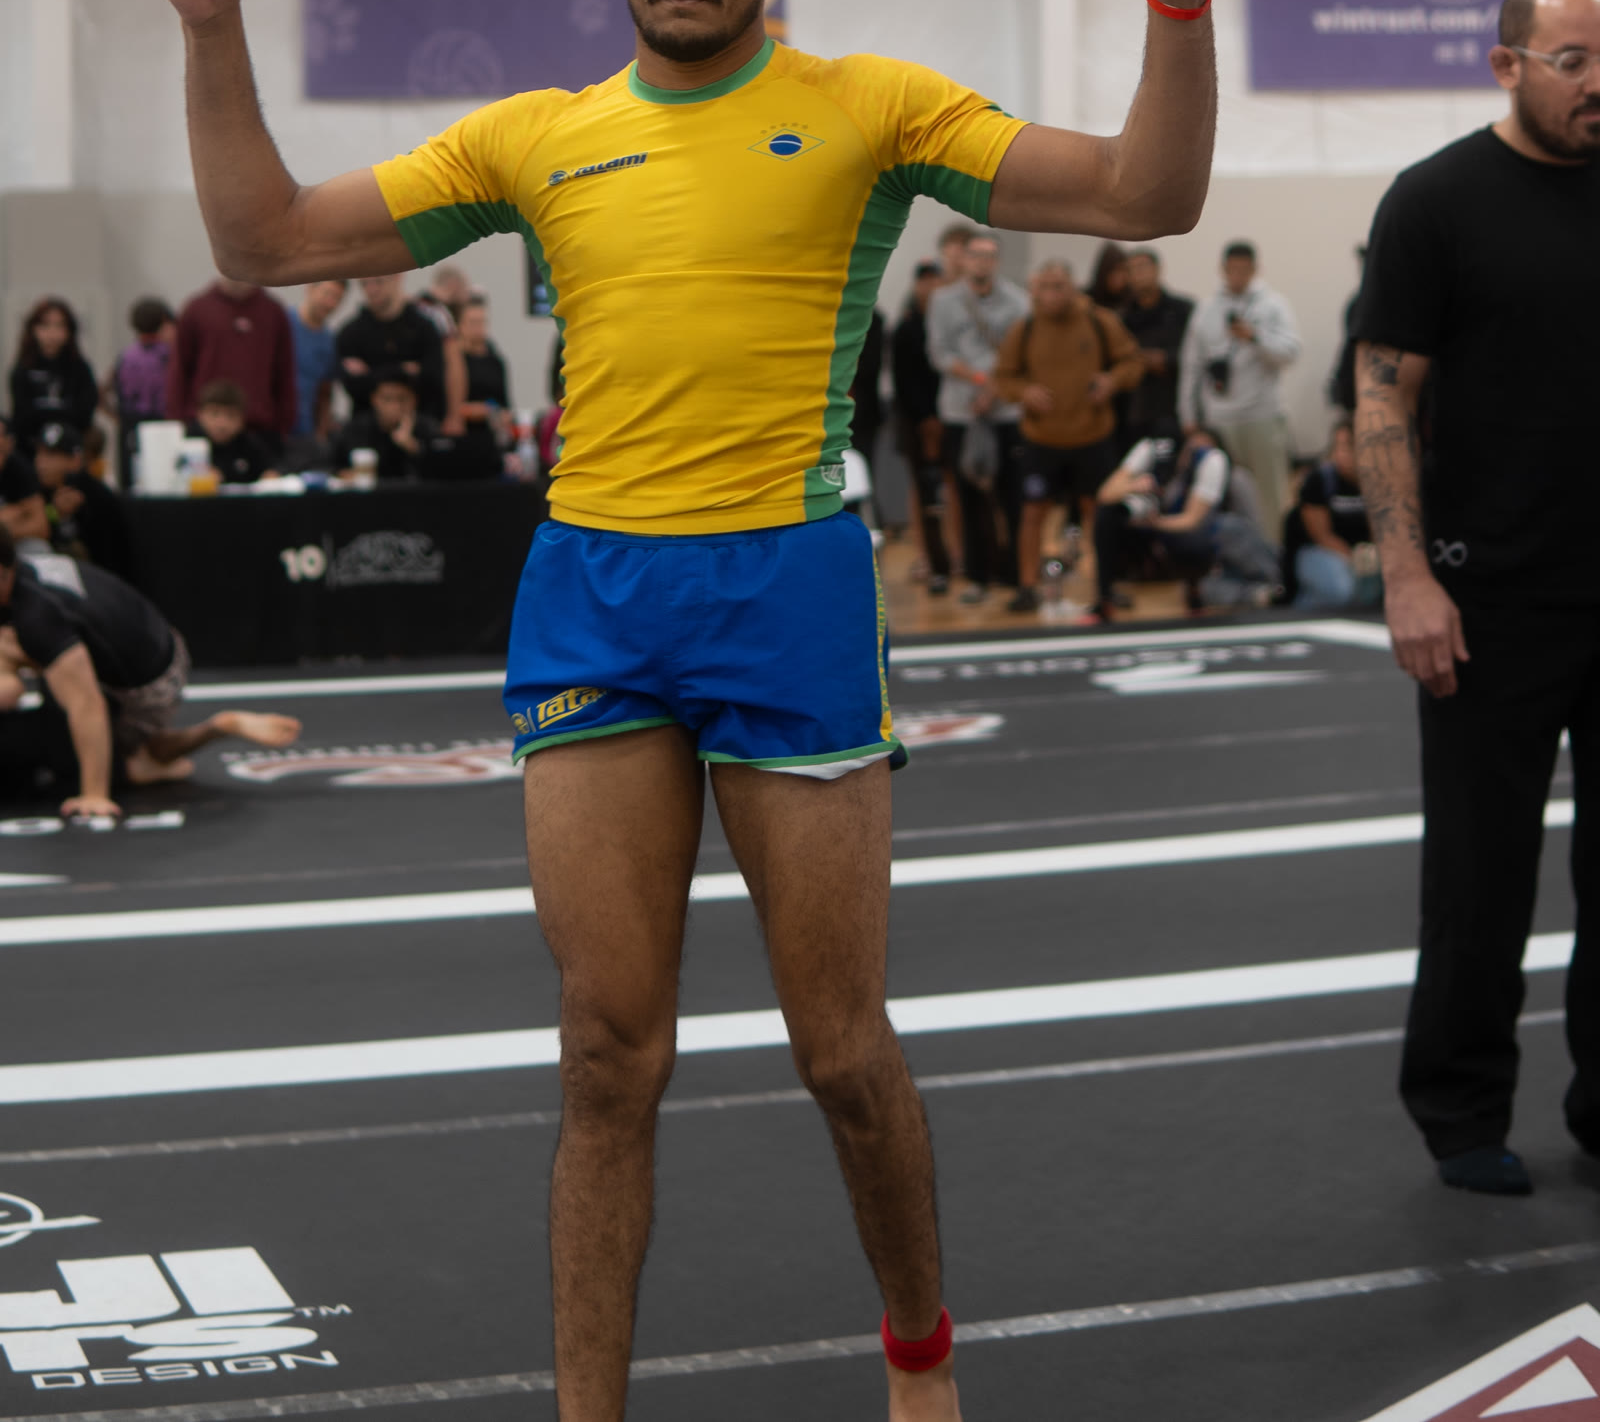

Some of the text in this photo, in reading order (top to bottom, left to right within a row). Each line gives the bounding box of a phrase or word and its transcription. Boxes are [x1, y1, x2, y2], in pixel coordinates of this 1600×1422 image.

[280, 545, 326, 581] 10
[537, 686, 606, 724] Tata
[32, 1351, 339, 1389] DESIGN
